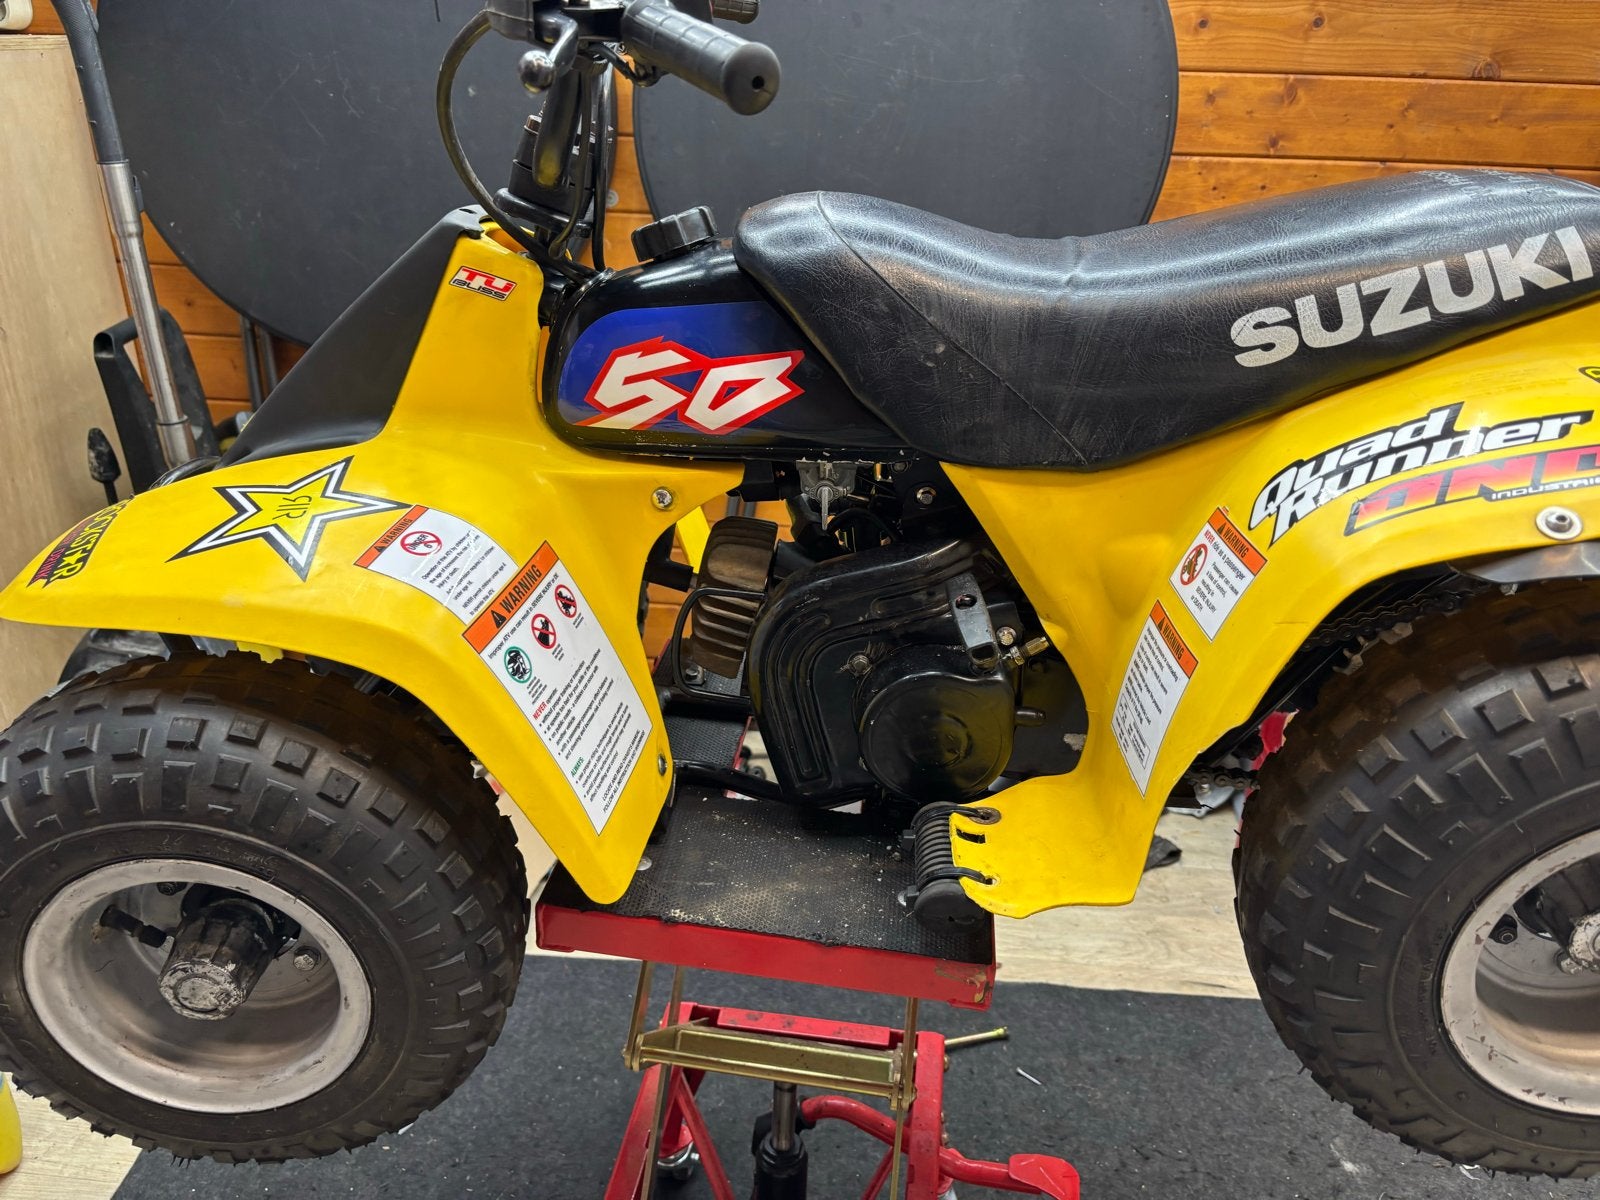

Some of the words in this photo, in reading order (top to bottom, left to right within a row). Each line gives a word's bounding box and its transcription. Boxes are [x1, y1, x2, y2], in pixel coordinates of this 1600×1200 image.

[452, 278, 507, 300] BLISS
[461, 267, 514, 293] TU
[1230, 226, 1594, 368] SUZUKI
[578, 340, 802, 433] 50
[1250, 405, 1460, 529] Quad
[1270, 411, 1592, 547] Runner
[379, 516, 413, 546] WARNING
[407, 532, 429, 552] UNDER
[1222, 526, 1249, 559] WARNING
[420, 563, 439, 580] Operation
[444, 548, 453, 557] ATV
[1203, 528, 1215, 545] NEVER
[1211, 539, 1221, 552] ride
[1222, 555, 1246, 584] passenger
[434, 570, 444, 579] age
[499, 561, 542, 616] WARNING
[487, 638, 505, 661] Improper
[501, 630, 511, 643] ATV
[508, 625, 517, 636] use
[514, 617, 523, 629] can
[519, 608, 530, 622] result
[530, 591, 544, 608] SEVERE
[541, 580, 553, 596] INJURY
[1162, 621, 1185, 661] WARNING
[532, 699, 547, 722] NEVER
[541, 706, 554, 726] without
[551, 694, 562, 711] proper
[559, 680, 571, 699] training
[569, 753, 584, 779] ALWAYS:
